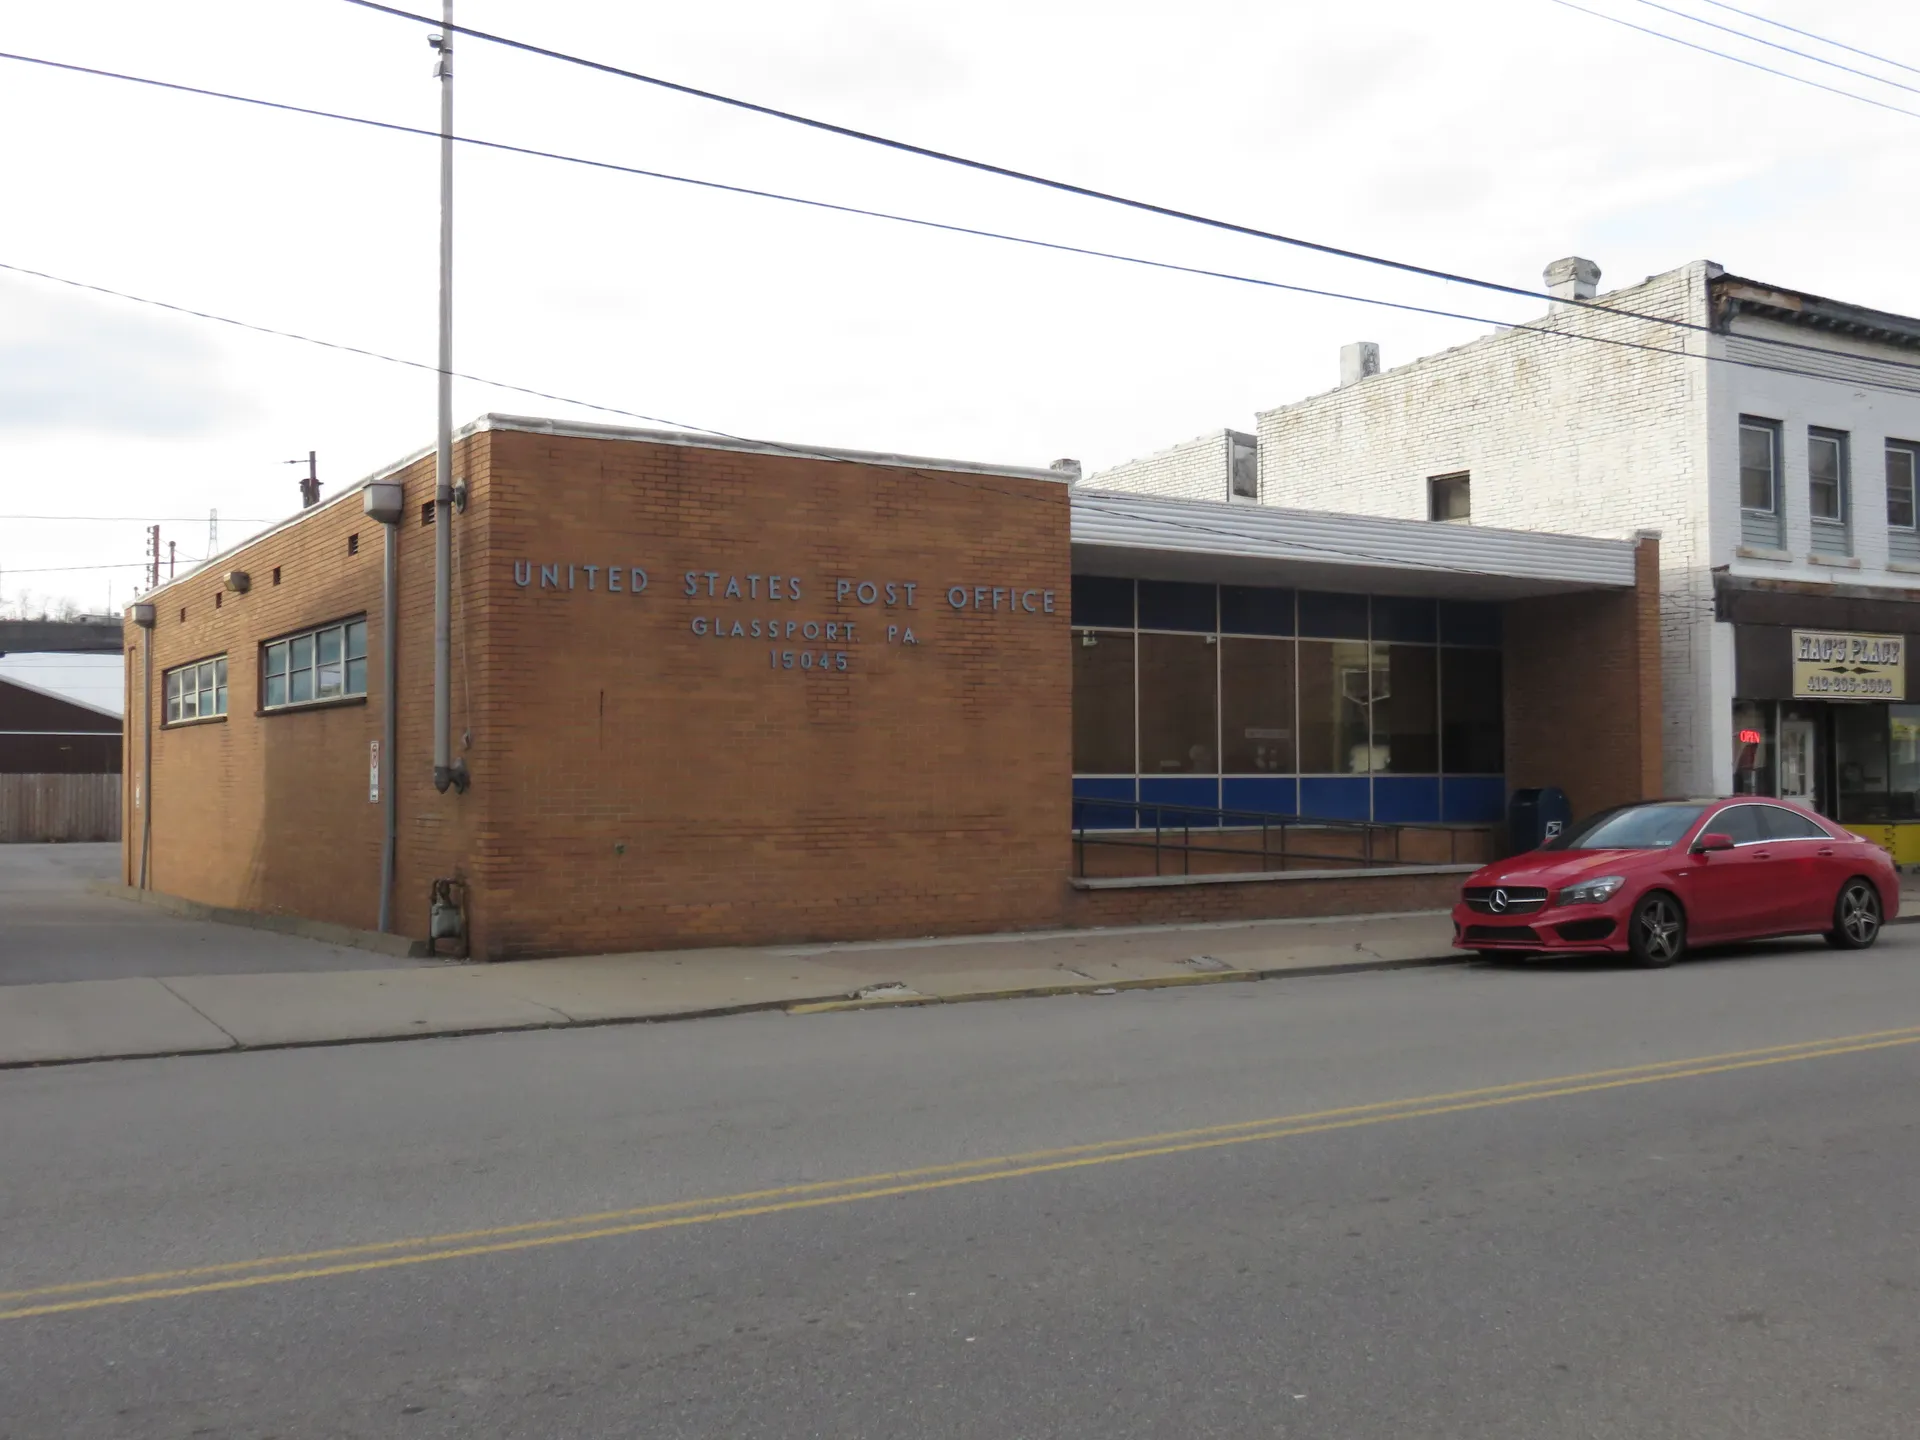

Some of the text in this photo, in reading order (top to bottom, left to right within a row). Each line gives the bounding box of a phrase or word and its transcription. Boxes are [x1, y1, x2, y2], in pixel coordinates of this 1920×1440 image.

[513, 560, 1055, 613] UNITED STATES POST OFFICE
[769, 650, 848, 670] 15045
[1798, 637, 1900, 666] HAG'S PLACE
[1739, 729, 1760, 744] OPEN
